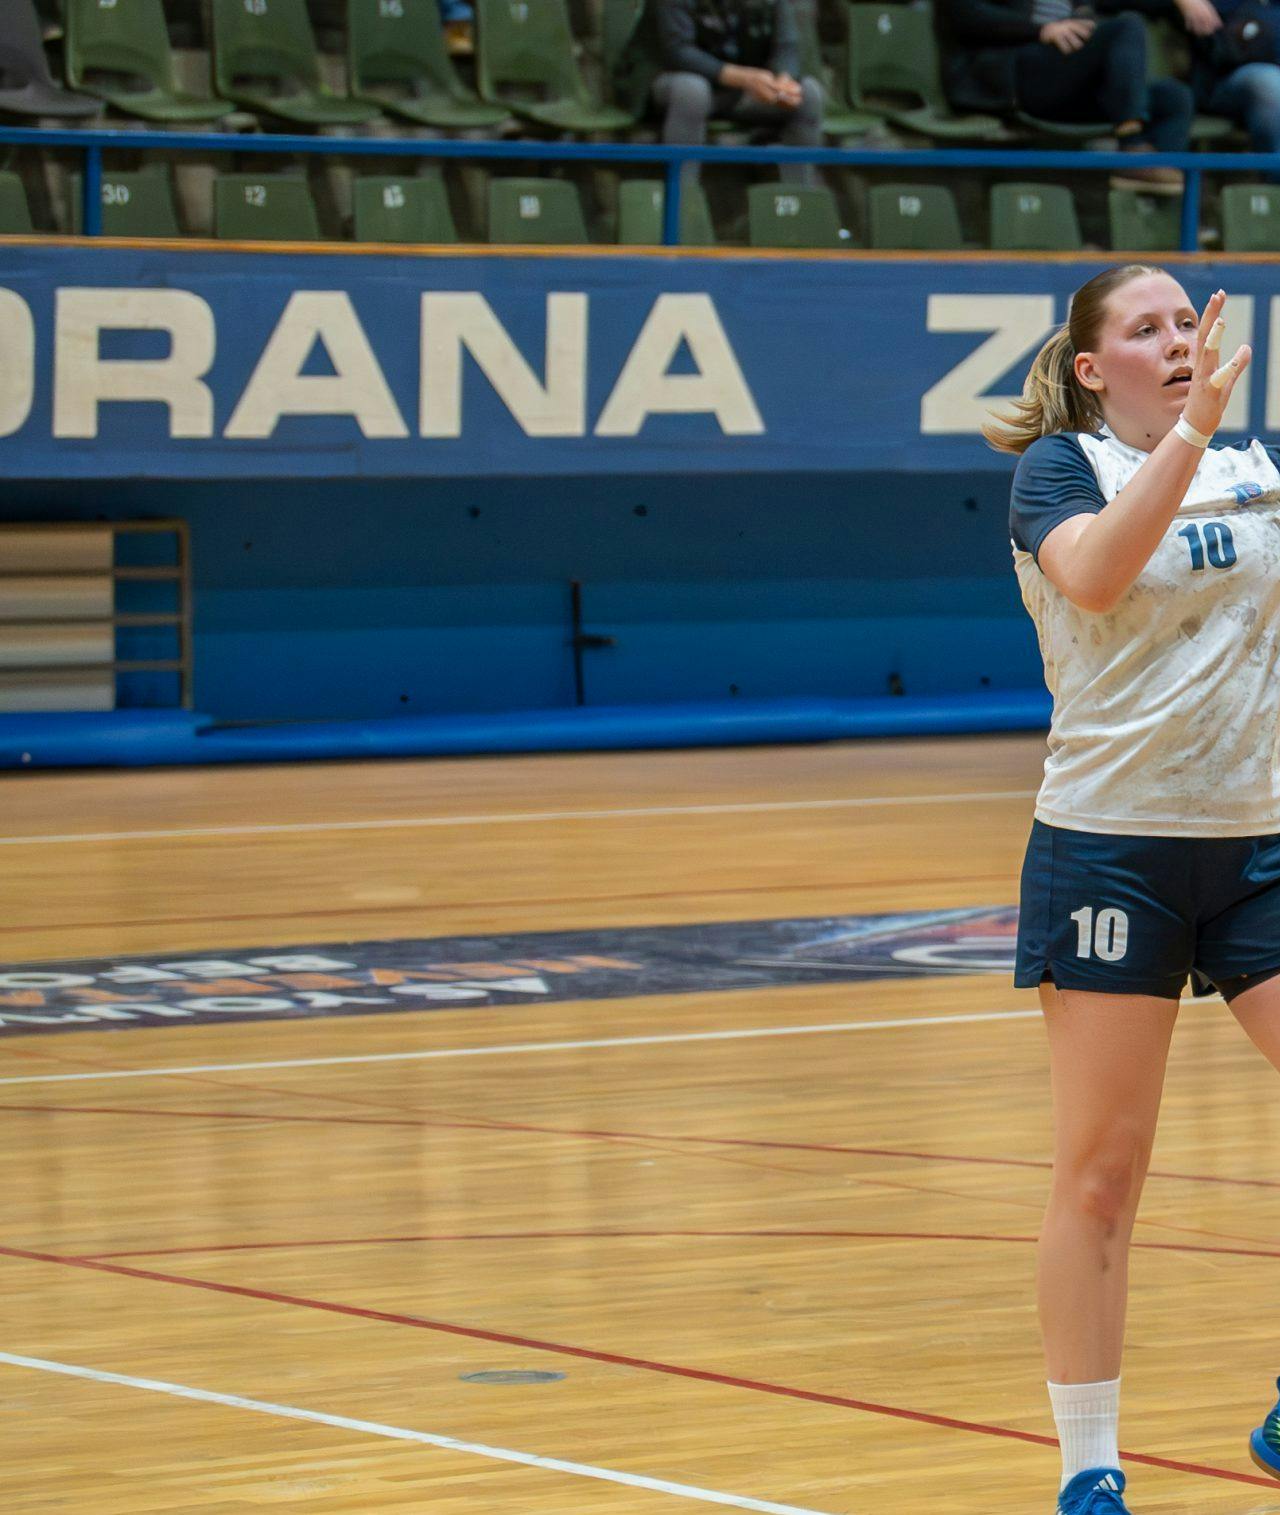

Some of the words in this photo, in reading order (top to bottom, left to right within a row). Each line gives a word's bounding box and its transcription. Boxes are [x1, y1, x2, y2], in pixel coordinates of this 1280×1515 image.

[0, 286, 766, 439] RANA
[1177, 522, 1238, 571] 10
[1070, 906, 1129, 961] 10
